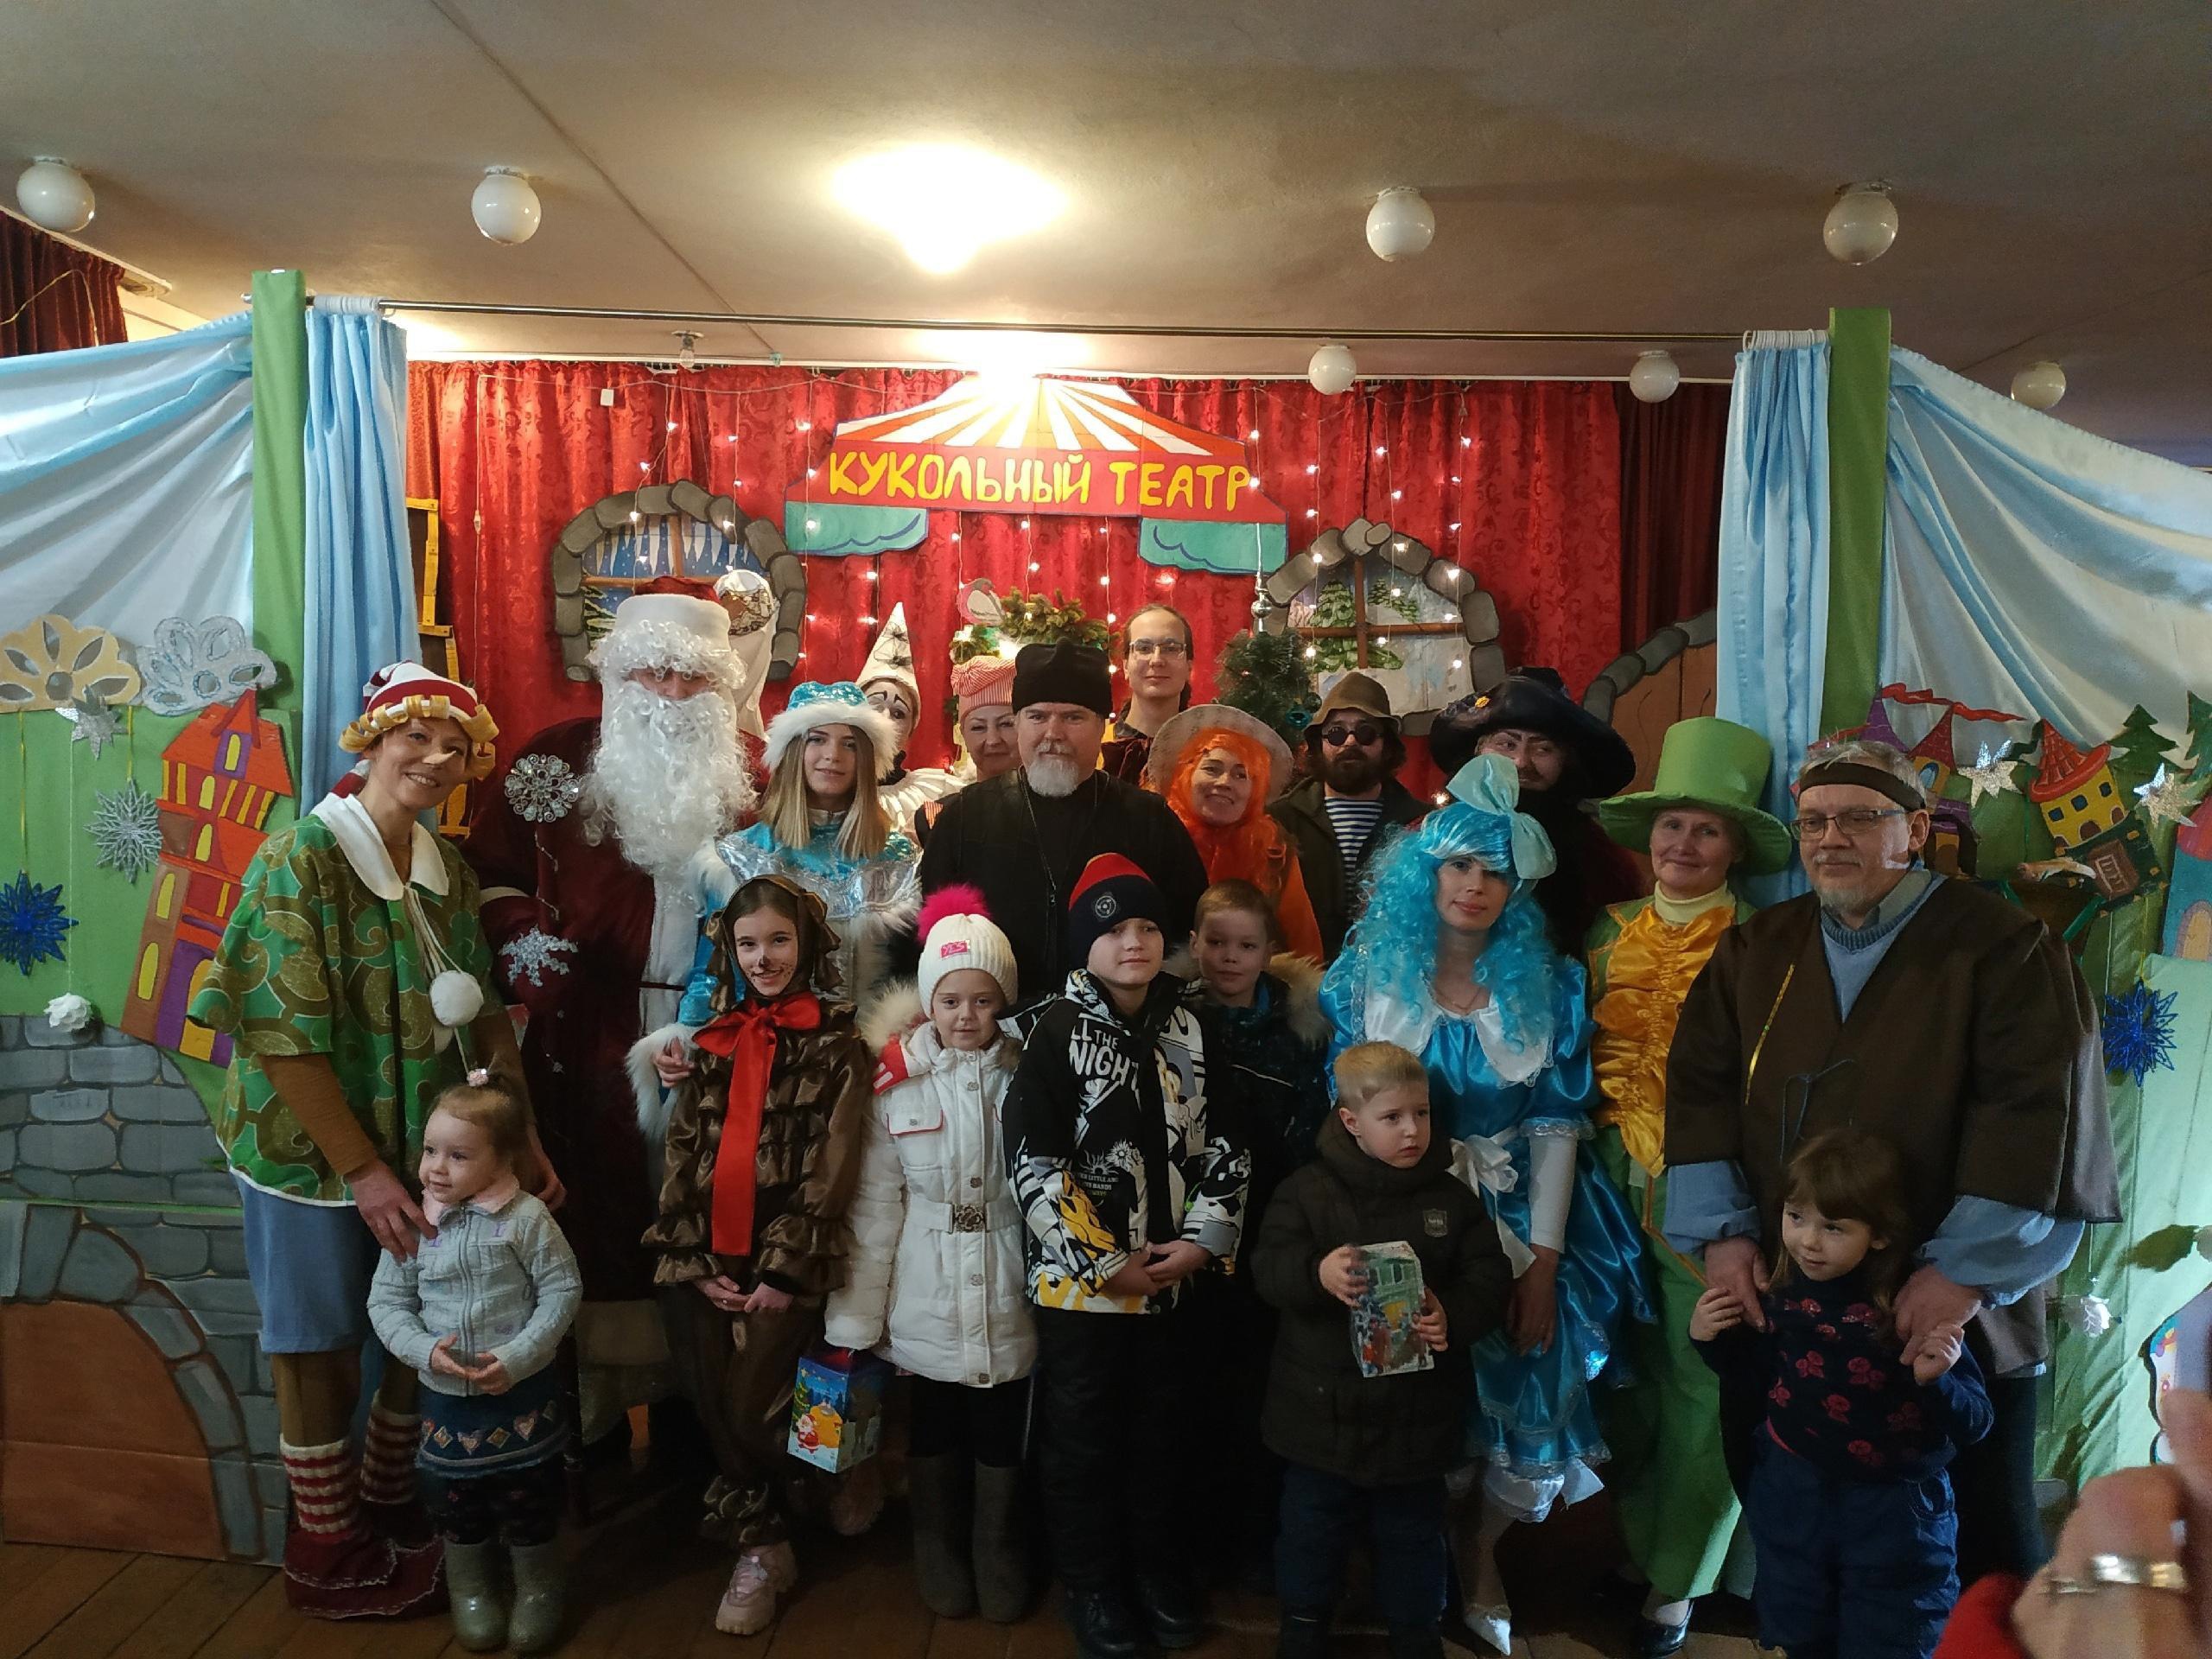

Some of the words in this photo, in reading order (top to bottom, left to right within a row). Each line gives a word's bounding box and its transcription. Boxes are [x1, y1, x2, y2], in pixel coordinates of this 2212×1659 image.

[828, 451, 1091, 505] КУКОЛЬНЫЙ
[1109, 461, 1250, 512] ТЕАТР
[1069, 1039, 1139, 1090] NIGHT
[1094, 1029, 1120, 1050] THE
